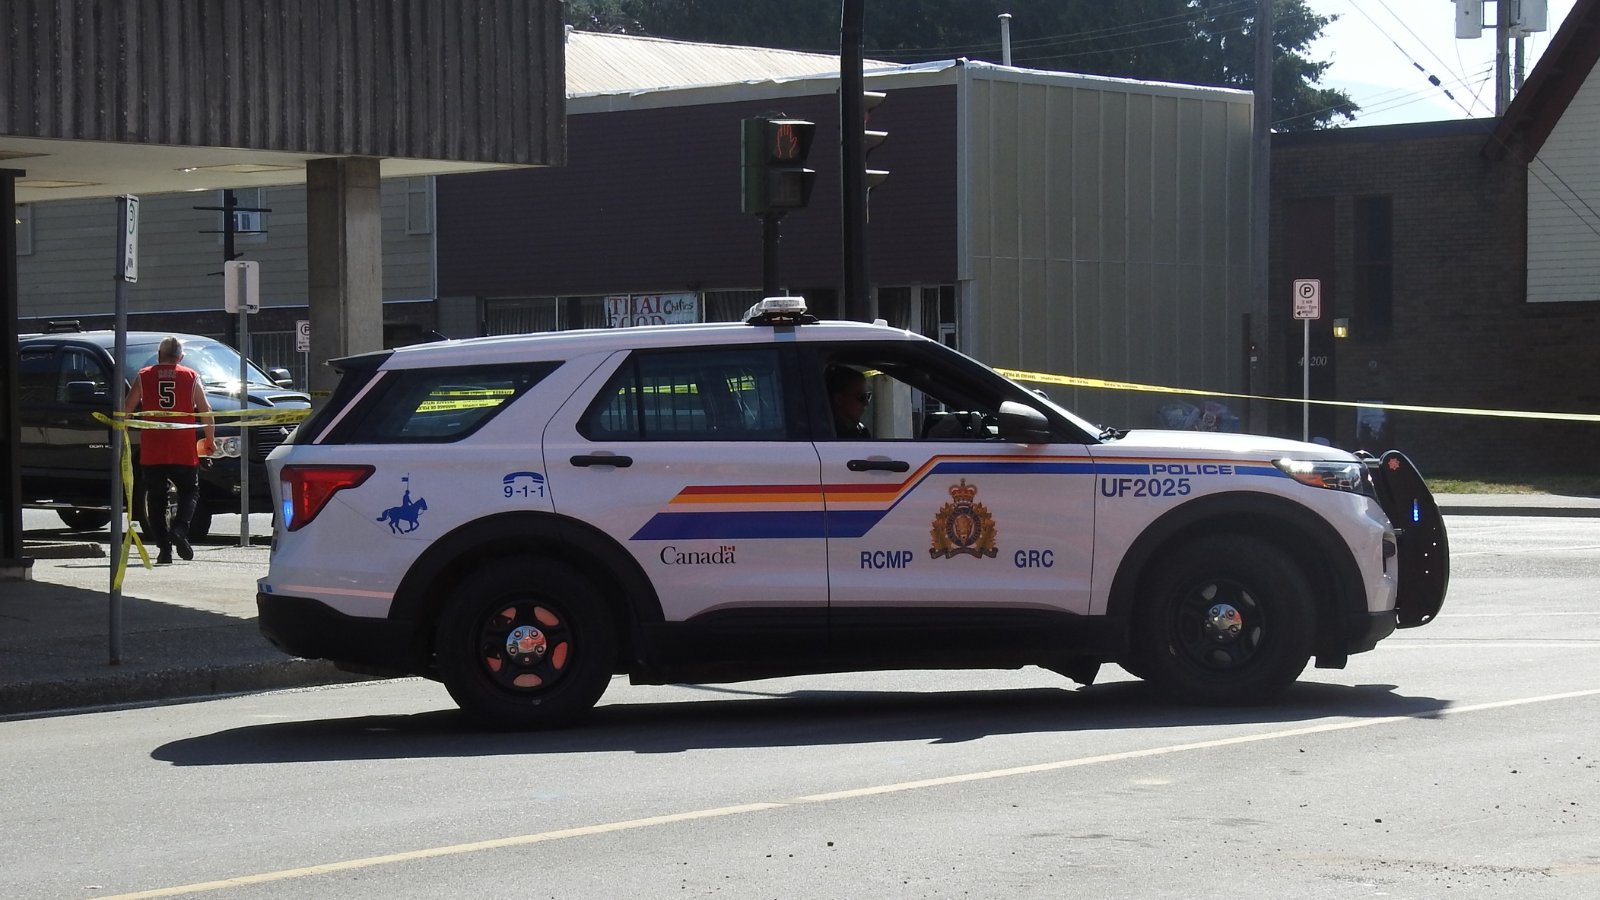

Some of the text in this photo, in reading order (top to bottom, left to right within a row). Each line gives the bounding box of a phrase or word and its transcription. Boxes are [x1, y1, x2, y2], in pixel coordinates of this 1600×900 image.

[609, 295, 662, 315] THAI
[1297, 356, 1328, 367] 4200
[158, 380, 176, 409] 5
[1151, 464, 1233, 475] POLICE
[503, 485, 544, 498] 9-1-1
[1101, 478, 1191, 498] UF2025
[660, 545, 736, 565] Canada
[860, 551, 914, 569] RCMP
[1014, 550, 1054, 568] GRC
